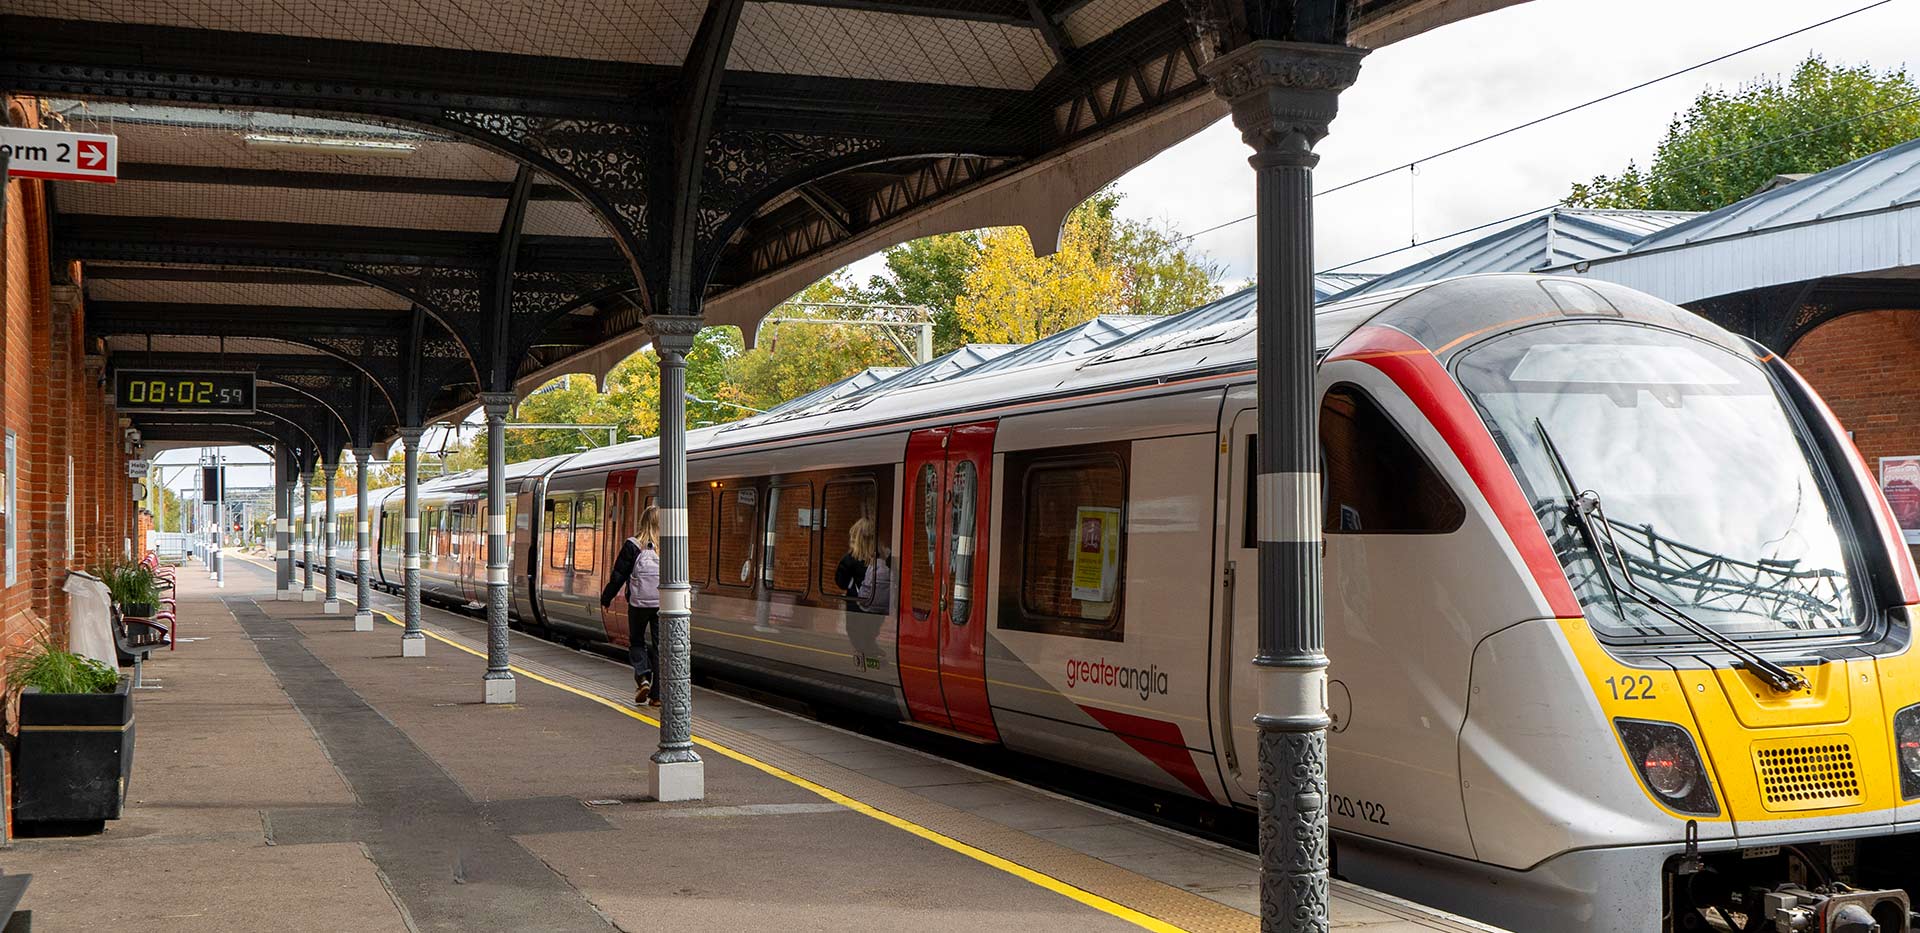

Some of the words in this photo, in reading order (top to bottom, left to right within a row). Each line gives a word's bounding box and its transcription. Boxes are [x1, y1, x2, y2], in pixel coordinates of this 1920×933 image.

[56, 143, 70, 162] 2
[1605, 675, 1656, 700] 122
[1356, 800, 1389, 826] 122
